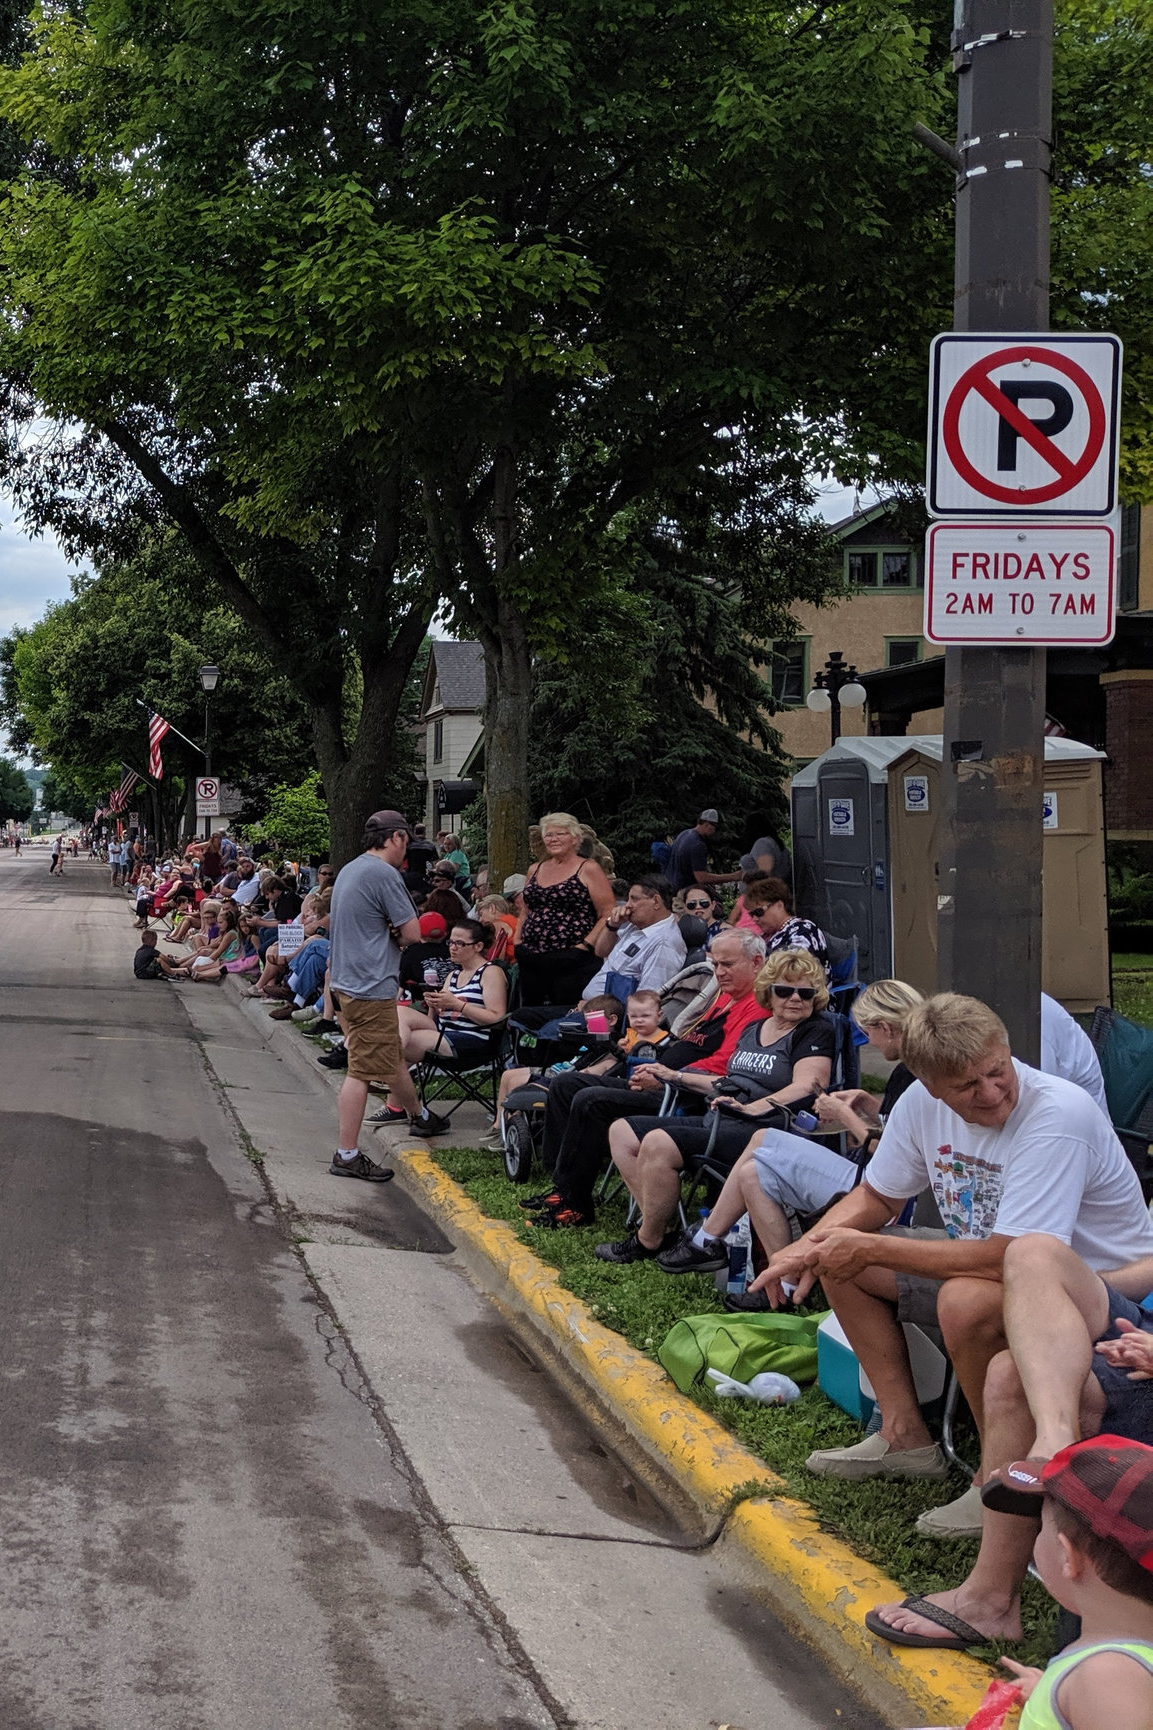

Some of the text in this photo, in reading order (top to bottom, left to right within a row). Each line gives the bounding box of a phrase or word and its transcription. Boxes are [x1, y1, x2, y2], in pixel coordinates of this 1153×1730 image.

[997, 380, 1074, 471] P
[951, 552, 1091, 581] FRIDAYS
[945, 592, 1096, 615] 2AM TO 7AM
[732, 1050, 777, 1070] LANCERS
